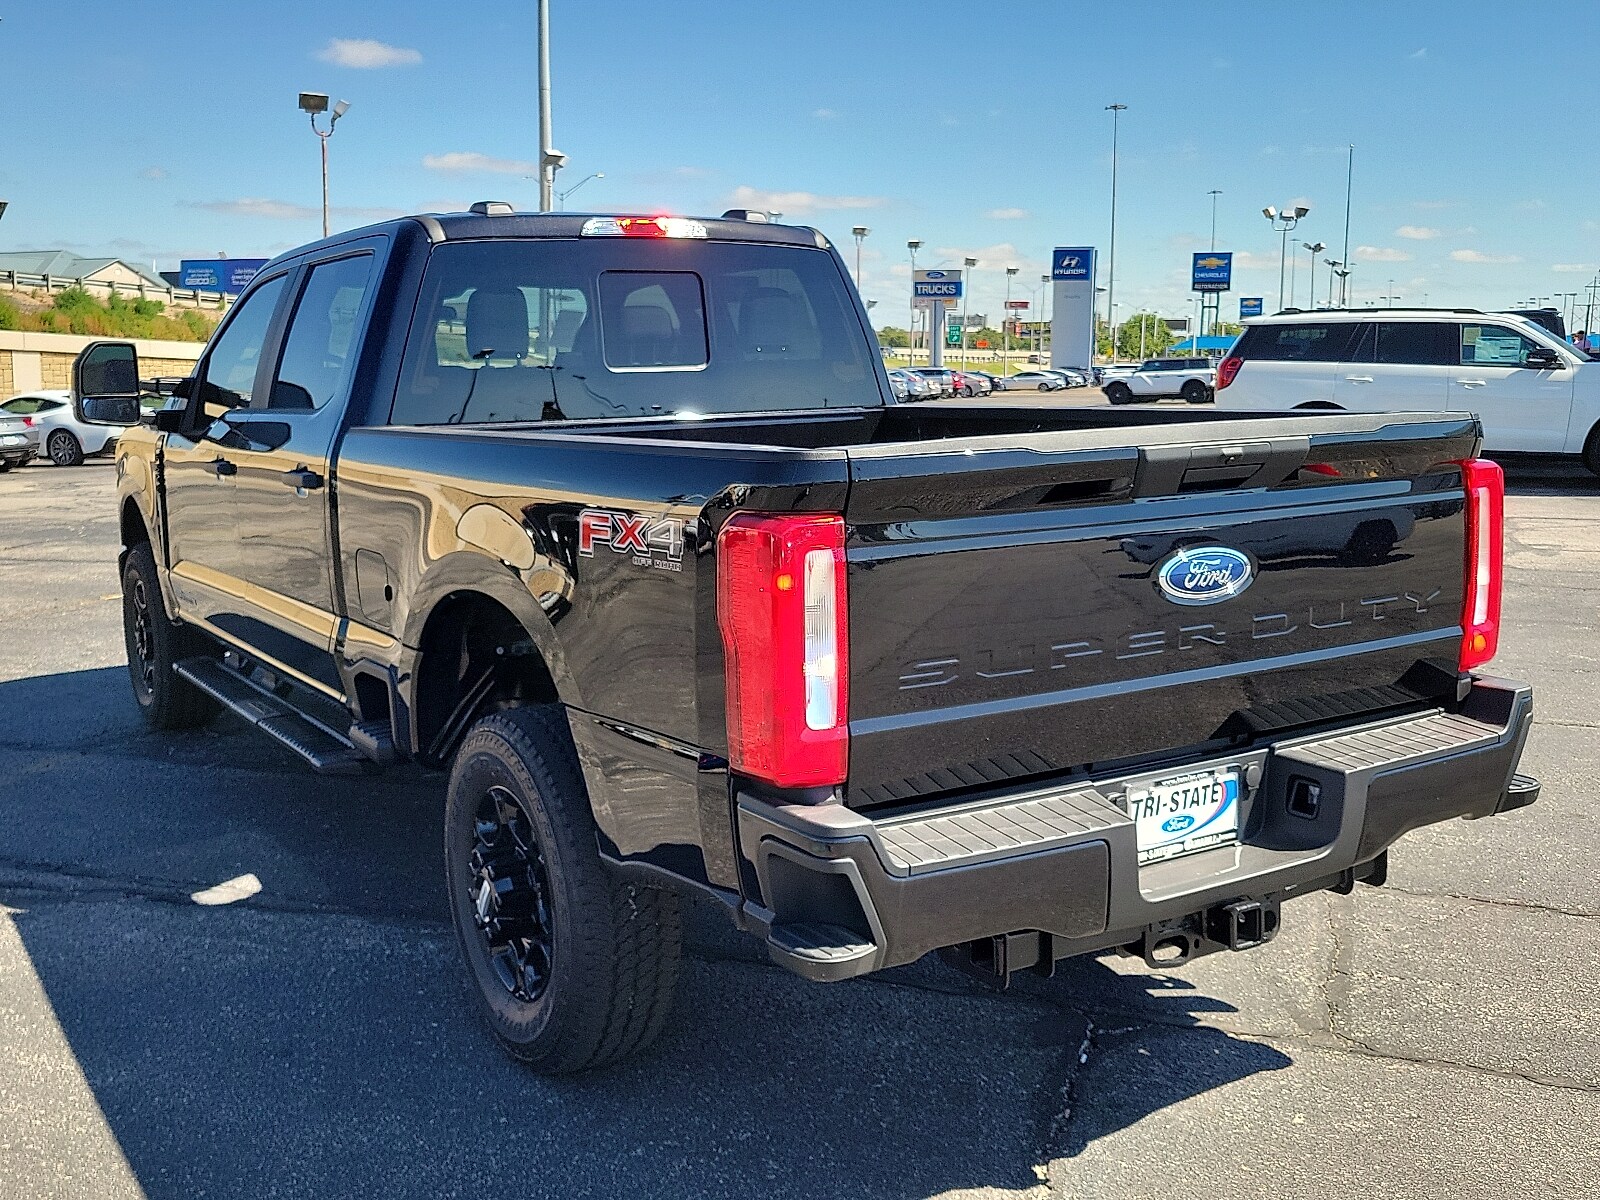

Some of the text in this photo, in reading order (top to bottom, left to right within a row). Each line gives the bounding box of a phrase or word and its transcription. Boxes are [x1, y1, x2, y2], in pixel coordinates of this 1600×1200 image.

[915, 284, 956, 295] TRUCKS
[578, 508, 684, 562] FX4
[1184, 558, 1234, 589] Ford
[898, 586, 1442, 691] SUPER DUTY
[1131, 782, 1222, 821] TRI-STATE
